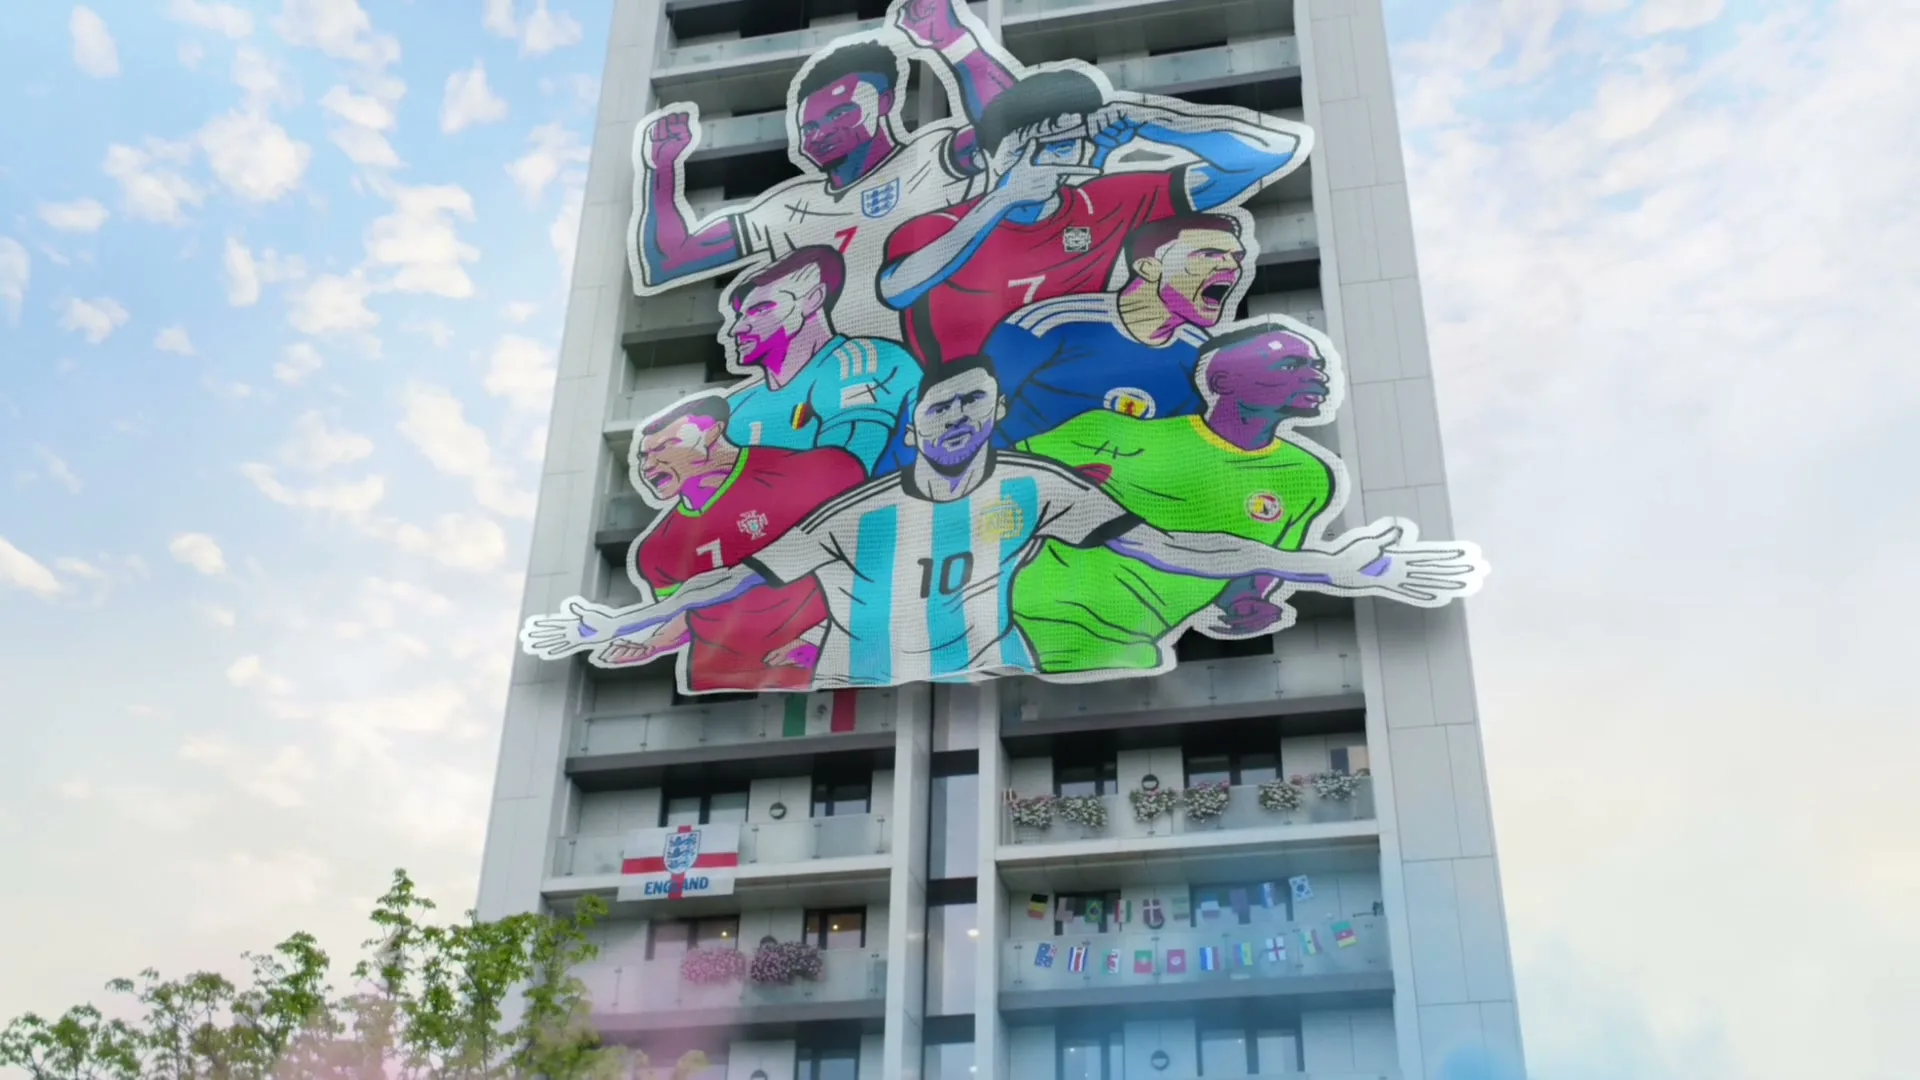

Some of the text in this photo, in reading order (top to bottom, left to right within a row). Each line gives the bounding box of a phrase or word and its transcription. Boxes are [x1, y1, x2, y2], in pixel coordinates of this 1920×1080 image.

[834, 225, 858, 254] 7
[1008, 274, 1046, 304] 7
[695, 537, 724, 568] 7
[917, 551, 974, 599] 10
